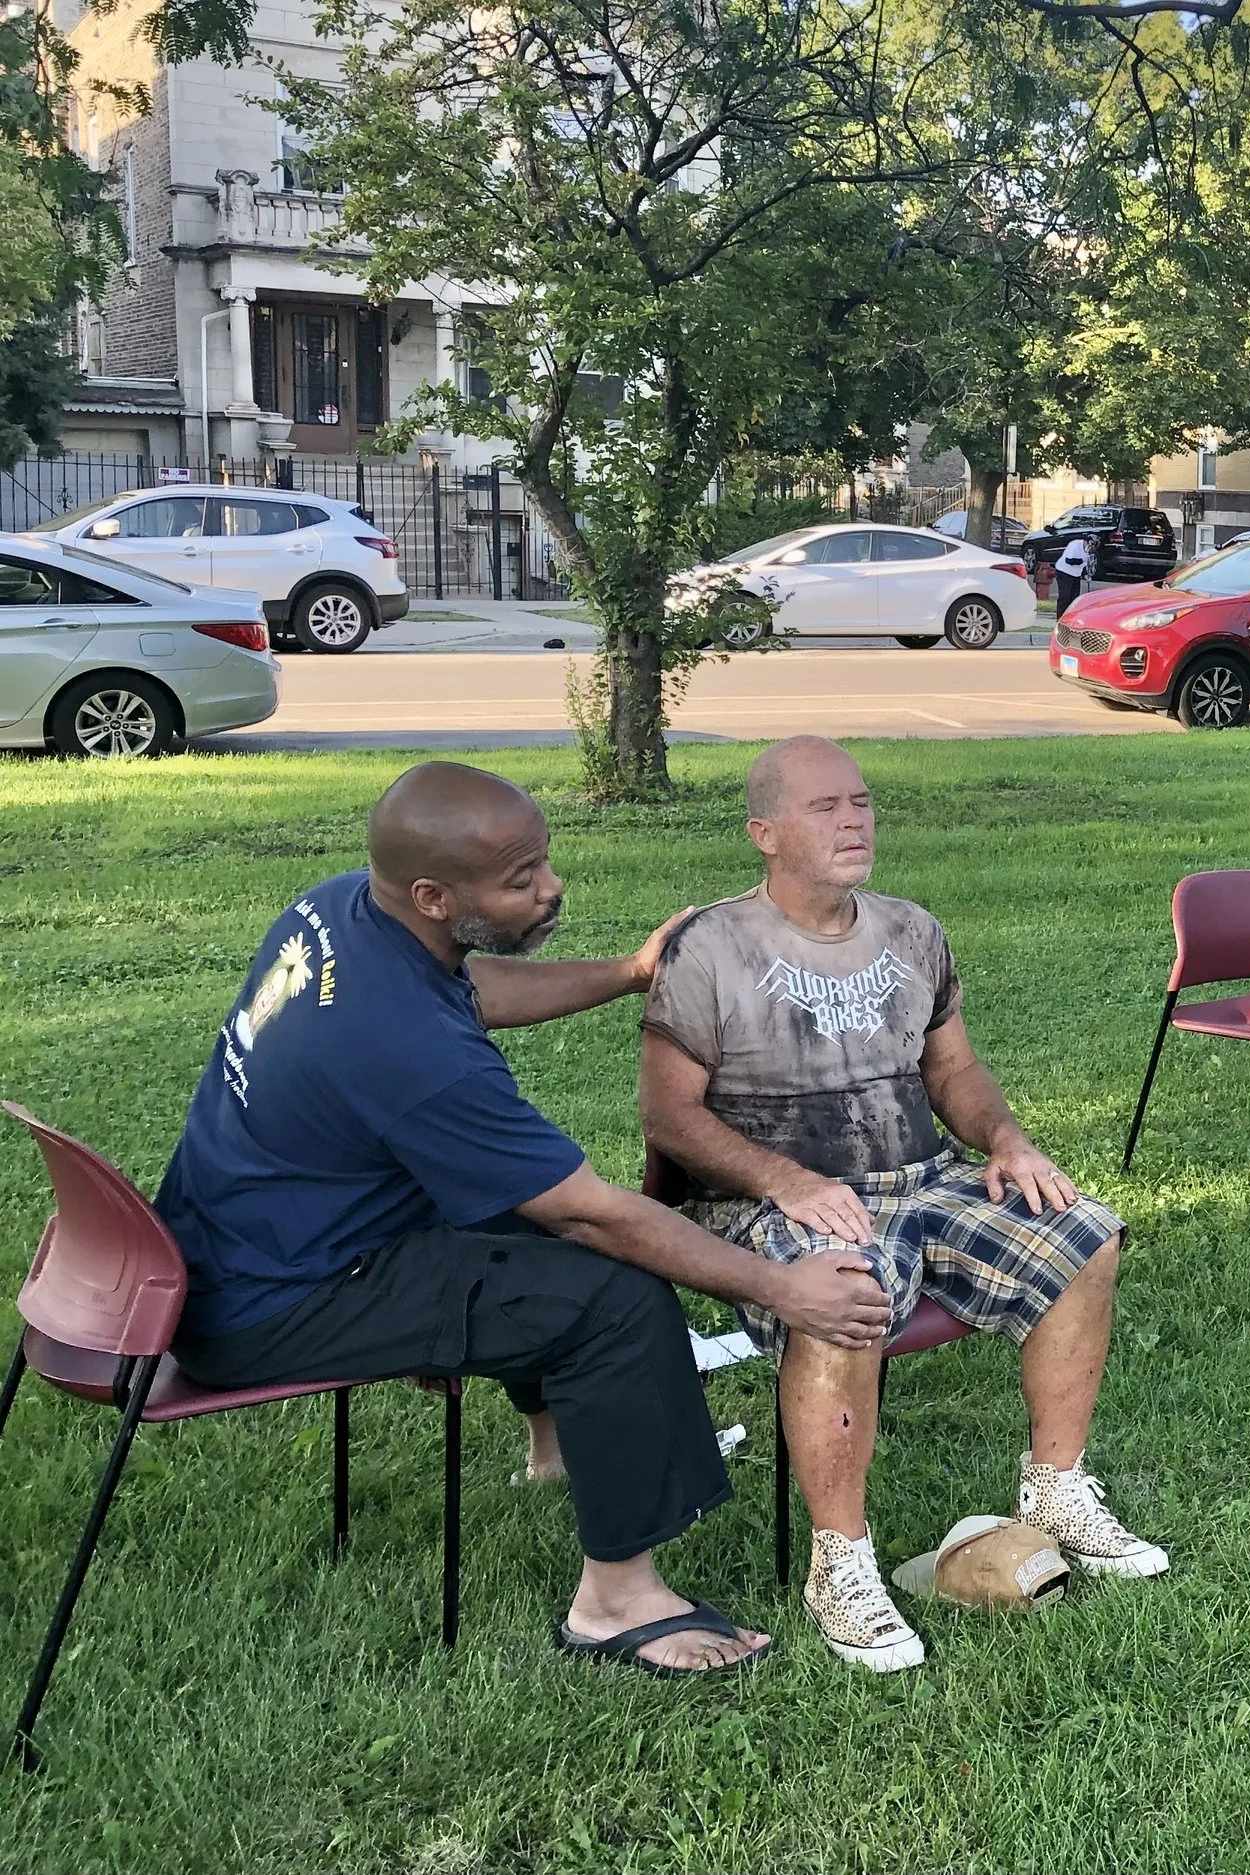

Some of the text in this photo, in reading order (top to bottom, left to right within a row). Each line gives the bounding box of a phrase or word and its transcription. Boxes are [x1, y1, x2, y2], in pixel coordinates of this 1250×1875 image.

[294, 899, 336, 1007] Ask me about Reiki!
[765, 946, 906, 1006] WORKING
[813, 997, 886, 1043] BIKES
